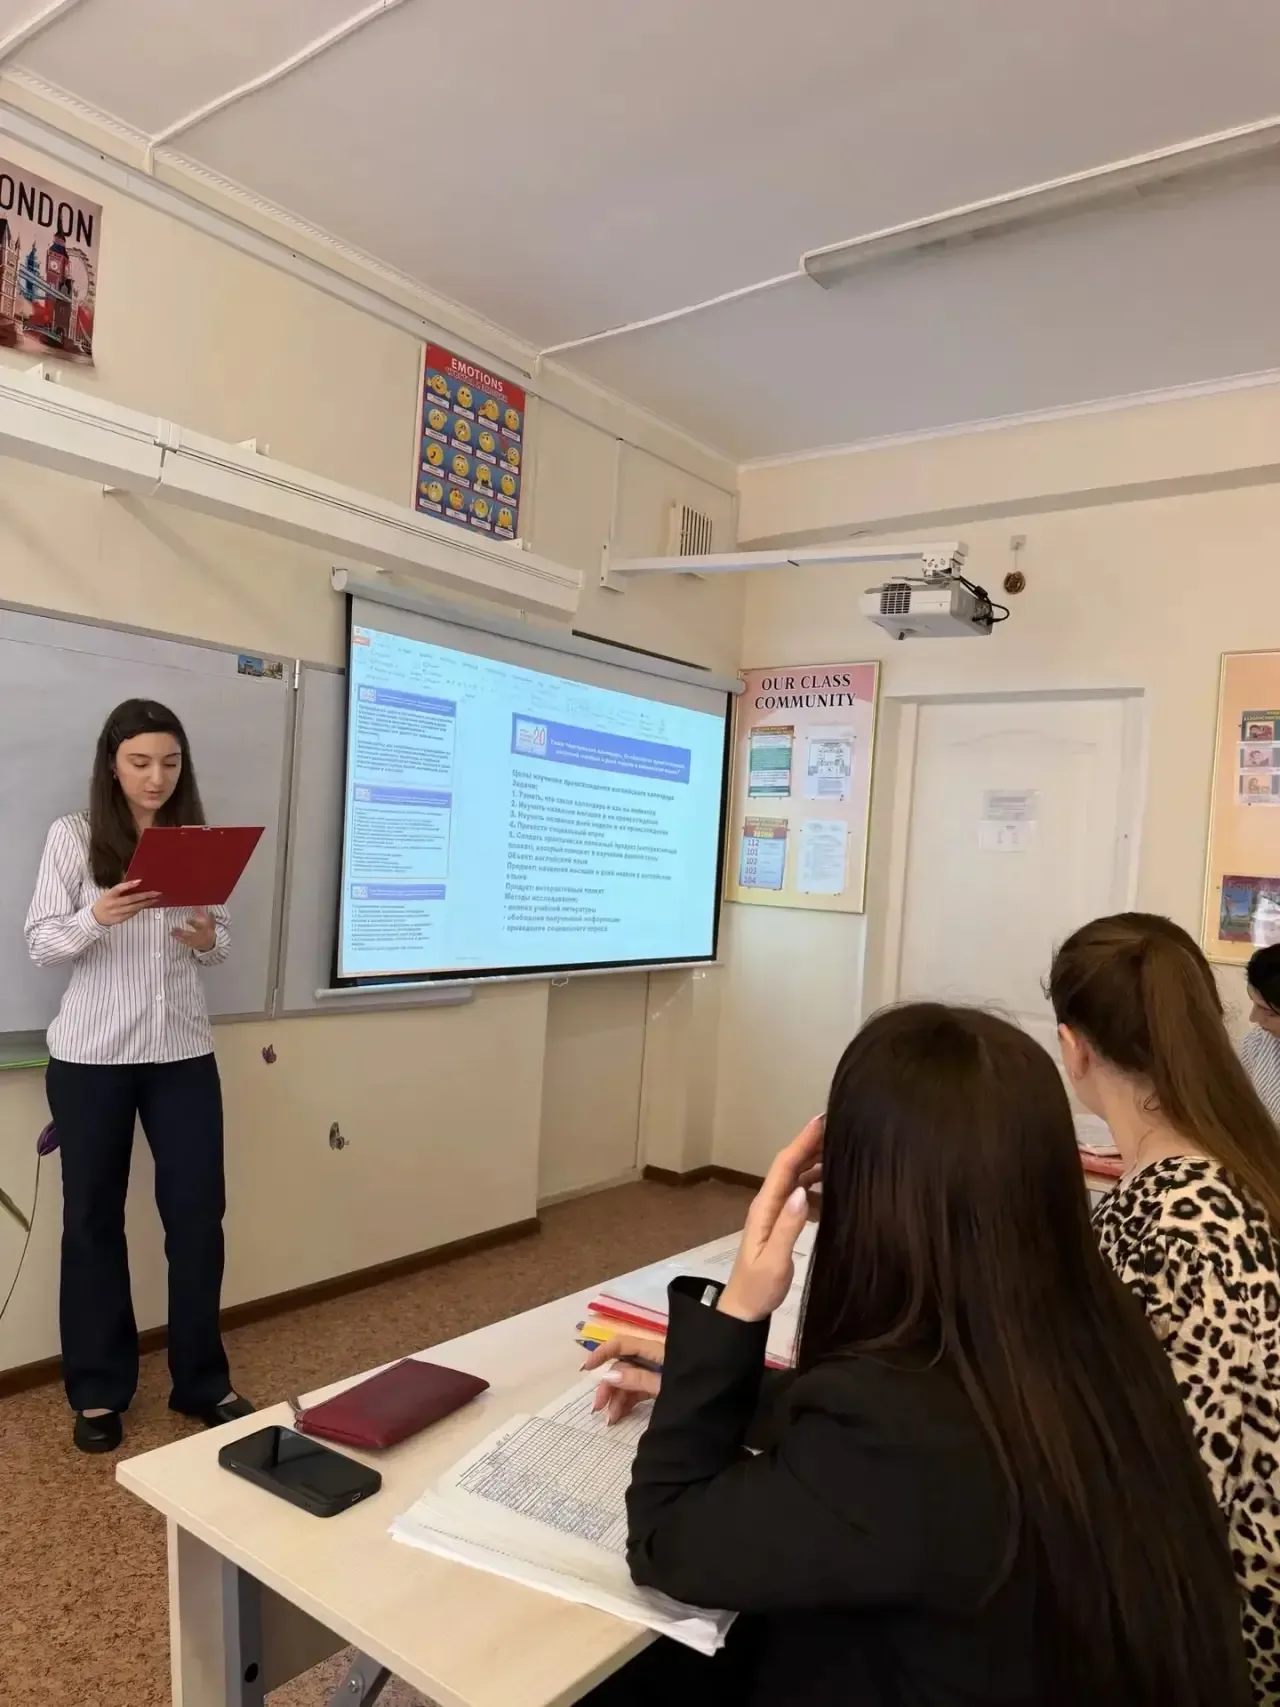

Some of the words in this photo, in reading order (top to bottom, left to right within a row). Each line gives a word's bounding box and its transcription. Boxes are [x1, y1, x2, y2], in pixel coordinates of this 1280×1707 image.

[0, 174, 94, 247] ONDON
[451, 358, 504, 392] EMOTIONS
[762, 677, 795, 690] OUR
[800, 674, 851, 689] CLASS
[755, 693, 856, 709] COMMUNITY
[748, 839, 759, 847] 112
[747, 848, 758, 856] 101
